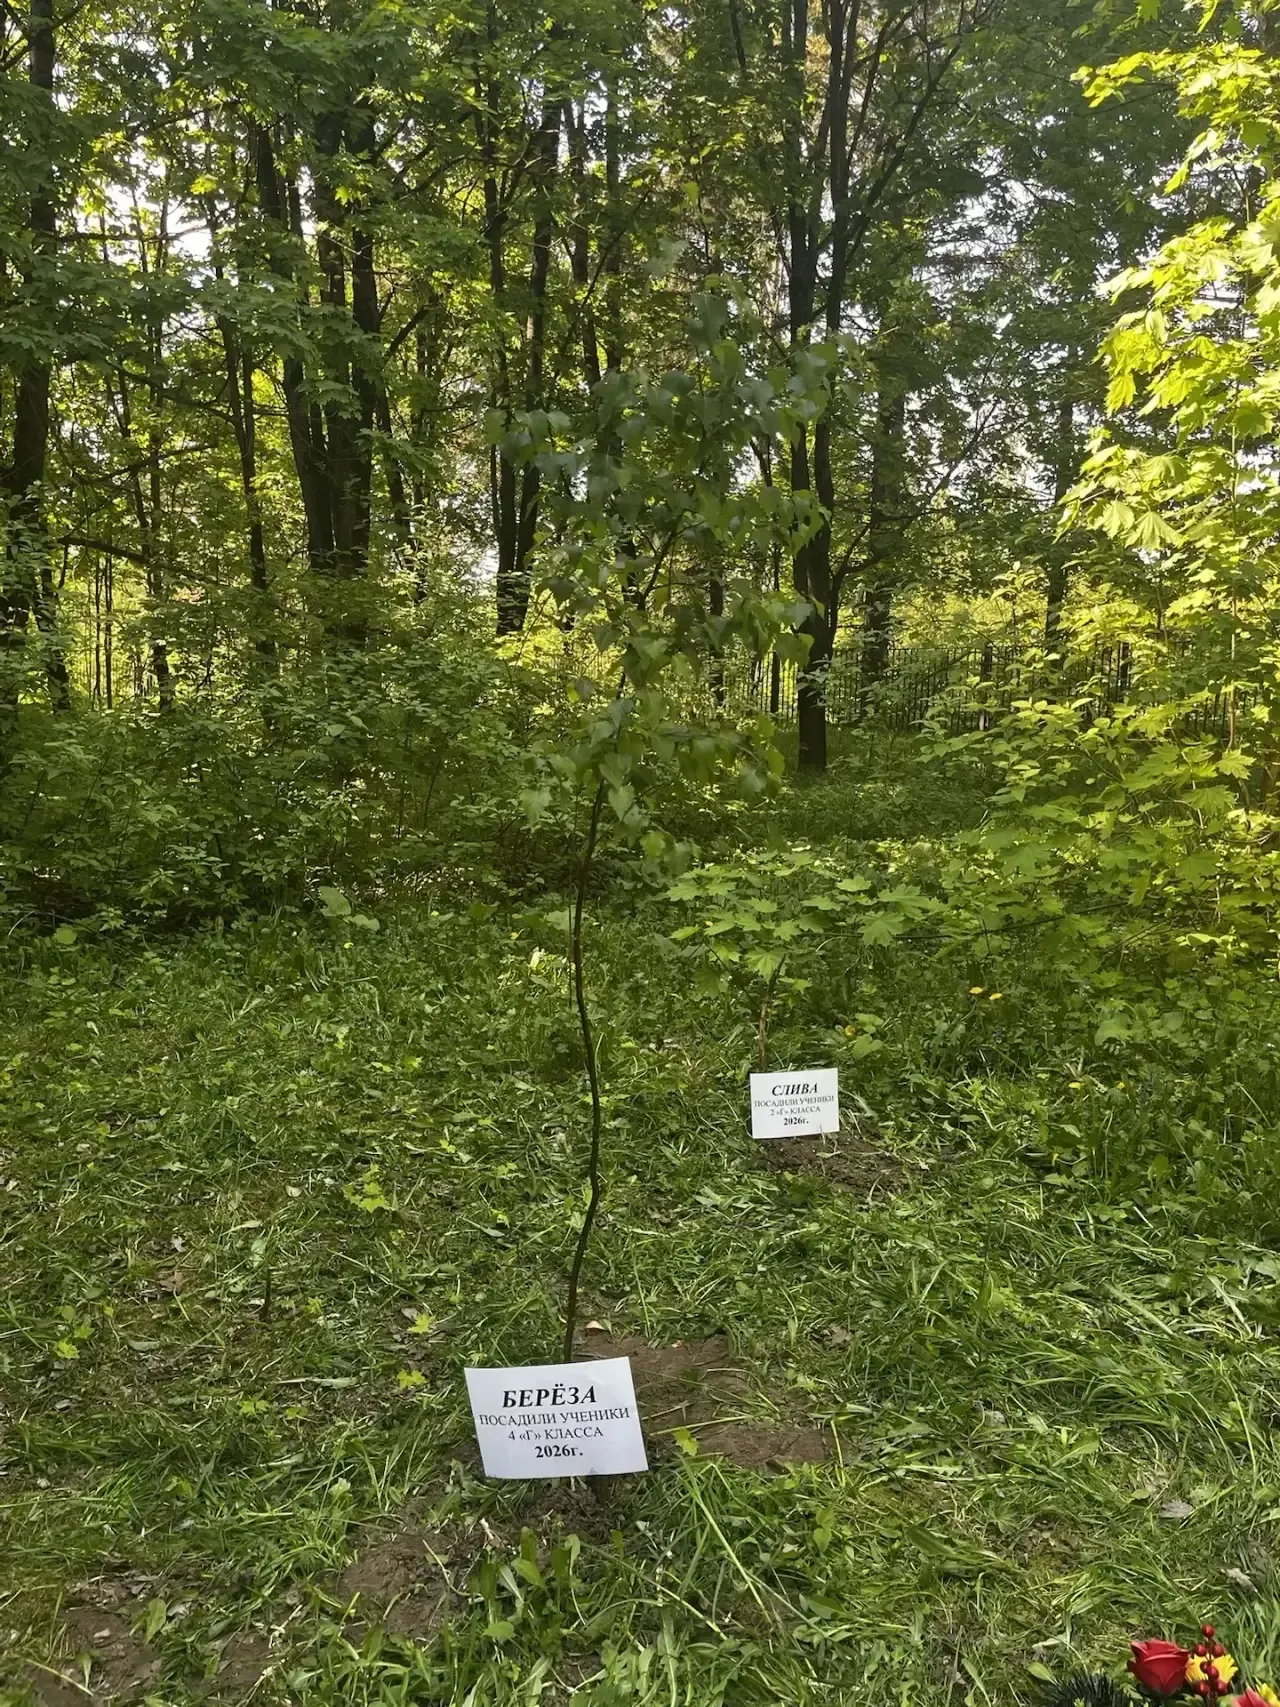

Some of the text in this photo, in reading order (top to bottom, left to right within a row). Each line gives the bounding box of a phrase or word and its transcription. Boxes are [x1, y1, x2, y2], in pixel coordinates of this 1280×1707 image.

[772, 1083, 818, 1096] СЛИВА
[754, 1095, 835, 1107] ПОСАДИЛИ УЧЕНИКИ
[790, 1106, 821, 1115] КЛАССА
[783, 1117, 809, 1126] 2026г.
[502, 1383, 597, 1408] БЕРЁЗА
[479, 1407, 630, 1427] ПОСАДИЛИ УЧЕНИКИ
[508, 1427, 604, 1441] 4 «Г» КЛАССА
[535, 1444, 584, 1458] 2026г.
